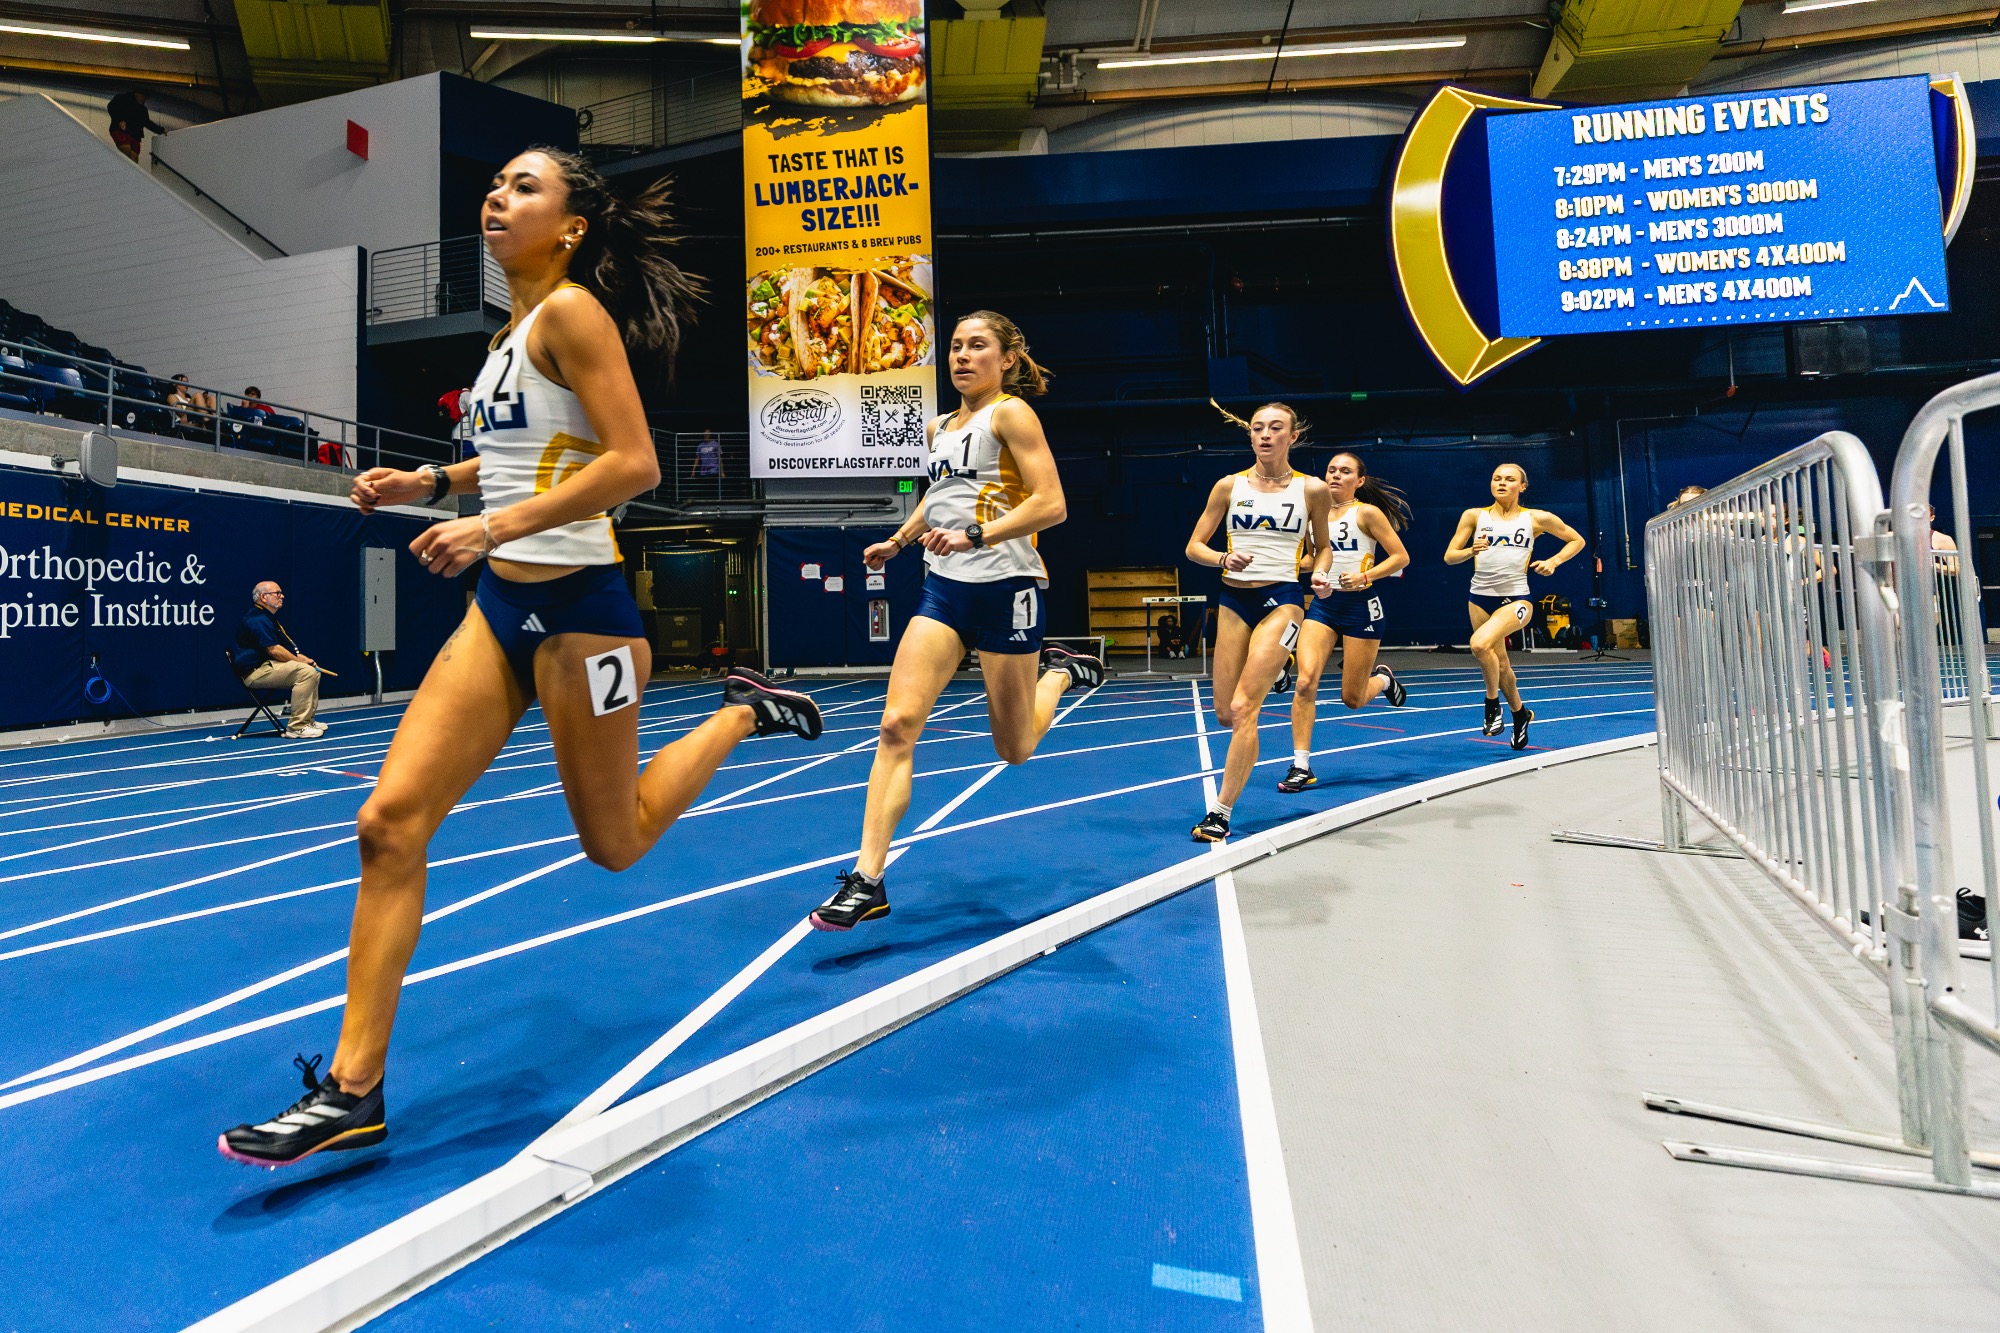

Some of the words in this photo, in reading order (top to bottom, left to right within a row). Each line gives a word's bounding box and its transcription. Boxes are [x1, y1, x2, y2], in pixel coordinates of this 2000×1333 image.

[1572, 104, 1706, 144] RUNNING
[1713, 93, 1829, 132] EVENTS
[768, 151, 828, 173] TASTE
[833, 147, 878, 169] THAT
[884, 146, 904, 165] IS
[1554, 161, 1626, 187] 7:29PM
[1643, 155, 1702, 180] MEN'S
[1708, 150, 1764, 174] 200M
[754, 173, 919, 206] LUMBERJACK-
[1555, 194, 1624, 219] 8:10PM
[1646, 185, 1742, 212] WOMEN'S
[1746, 179, 1818, 204] 3000M
[801, 203, 880, 232] SIZE!!!
[1556, 224, 1632, 249] 8:24PM
[1648, 218, 1708, 243] MEN'S
[1712, 212, 1783, 238] 3000M
[756, 247, 781, 257] 200+
[783, 240, 849, 255] RESTAURANTS
[852, 239, 859, 249] &
[861, 238, 868, 248] 8
[870, 236, 895, 248] BREW
[897, 235, 922, 245] PUBS
[1558, 256, 1633, 281] 8:38PM
[1655, 248, 1750, 274] WOMEN'S
[1755, 241, 1846, 267] 4X400M
[1561, 287, 1635, 312] 9:02PM
[1657, 281, 1717, 306] MEN'S
[1721, 275, 1812, 302] 4X400M
[493, 347, 511, 402] 2
[469, 392, 528, 436] AU
[767, 401, 833, 426] Flagstaff
[775, 420, 828, 434] discoverflagstaff.com
[768, 456, 920, 470] DISCOVERFLAGSTAFF.COM
[961, 432, 973, 467] 1
[899, 481, 913, 492] EXIT
[105, 512, 190, 533] CENTER
[1281, 503, 1295, 527] 7
[1338, 521, 1349, 541] 3
[1514, 528, 1525, 544] 6
[180, 553, 206, 585] &
[90, 593, 215, 627] Institute
[1020, 592, 1031, 627] 1
[1371, 599, 1381, 619] 3
[1516, 606, 1527, 620] 6
[1284, 622, 1299, 646] 7
[597, 655, 629, 711] 2
